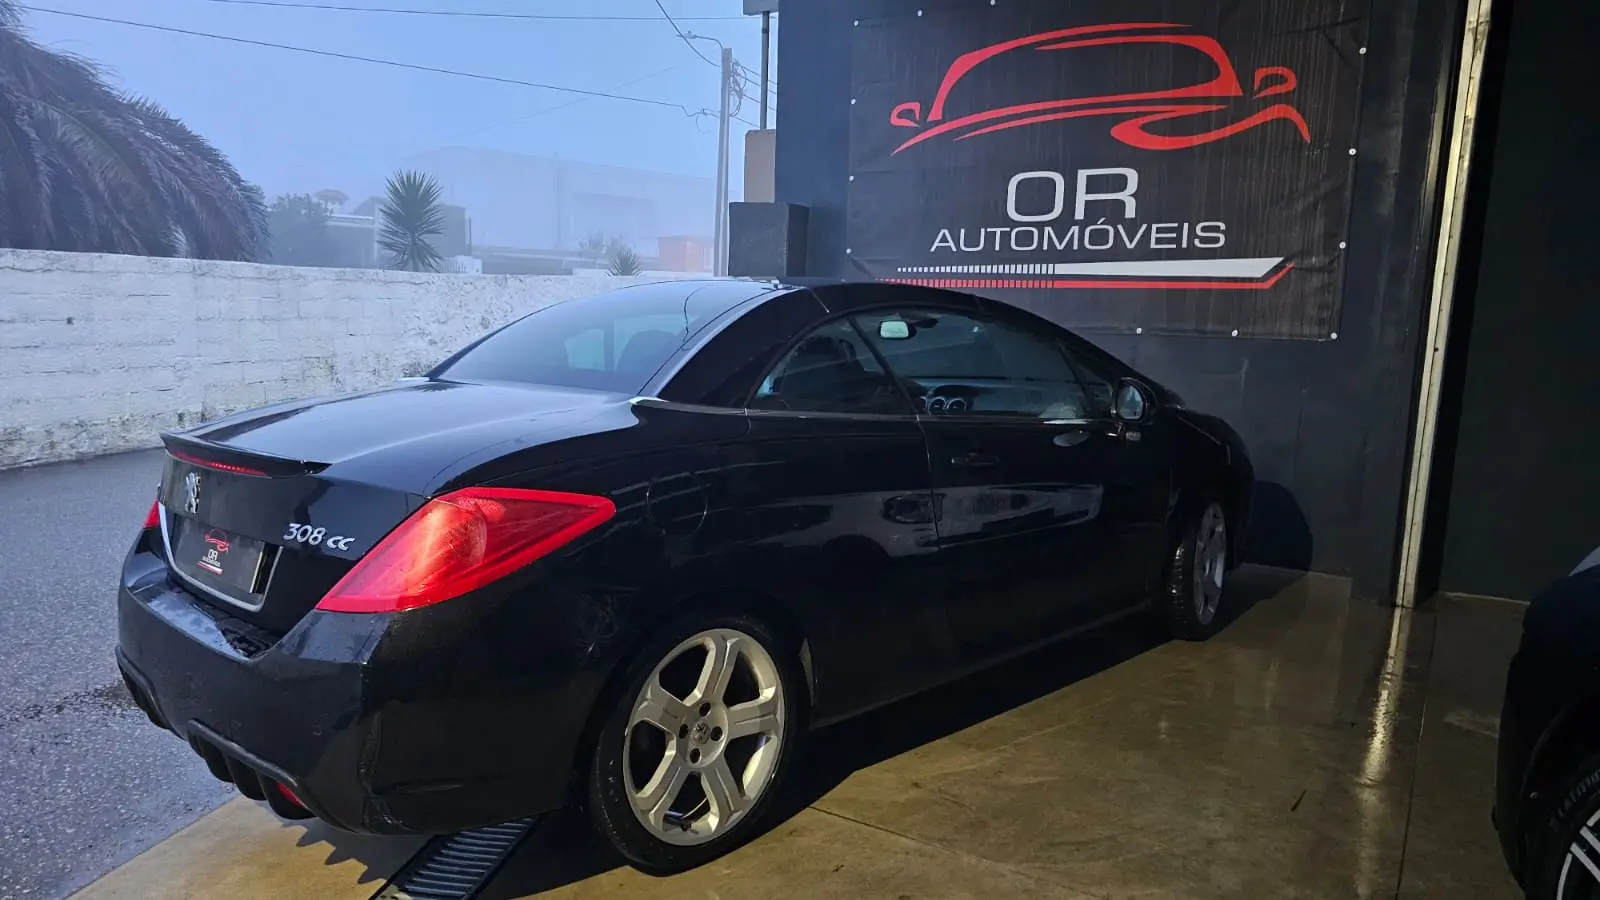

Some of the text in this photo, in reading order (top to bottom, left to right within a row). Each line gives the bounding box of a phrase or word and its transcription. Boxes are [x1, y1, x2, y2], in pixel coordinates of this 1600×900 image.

[1006, 167, 1140, 222] OR
[929, 218, 1227, 253] AUTOMÓVEIS
[283, 523, 326, 546] 308
